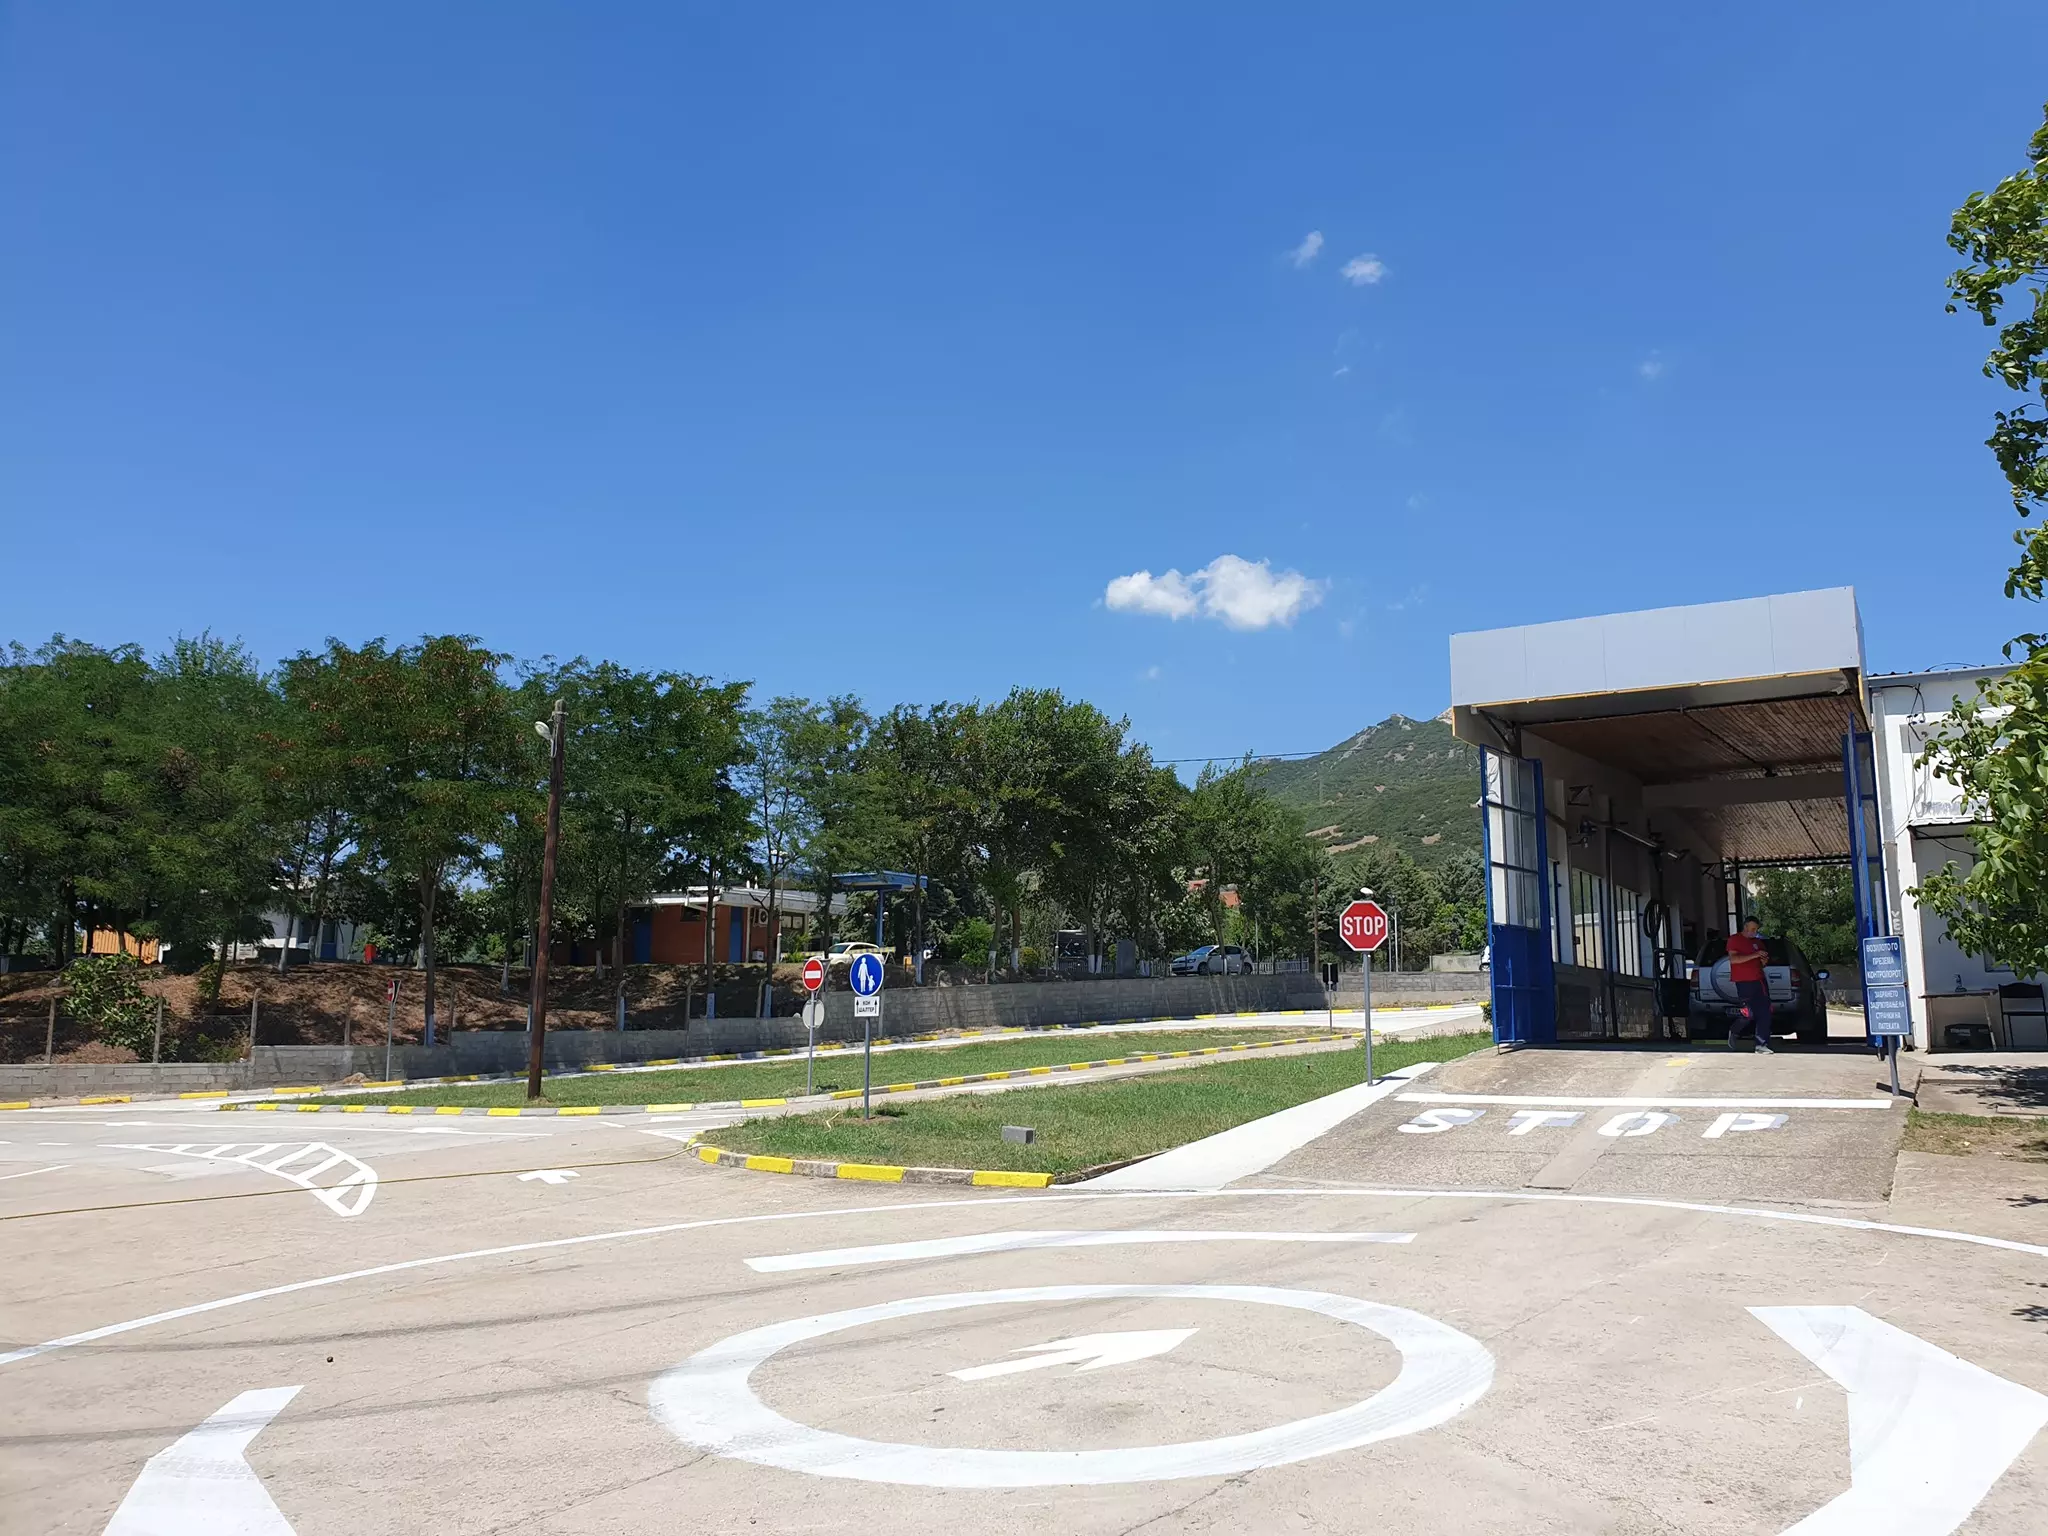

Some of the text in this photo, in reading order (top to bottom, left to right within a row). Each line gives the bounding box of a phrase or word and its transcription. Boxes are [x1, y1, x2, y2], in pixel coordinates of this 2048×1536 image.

[1343, 916, 1384, 936] STOP
[1866, 942, 1899, 953] ВОЗИЛОТО ГО
[1872, 956, 1894, 965] ПРЕЗЕМА
[1867, 970, 1901, 979] КОНТРОЛОРОТ
[1899, 1000, 1905, 1008] НА
[1895, 1011, 1901, 1019] НА
[1397, 1108, 1789, 1139] STOP
